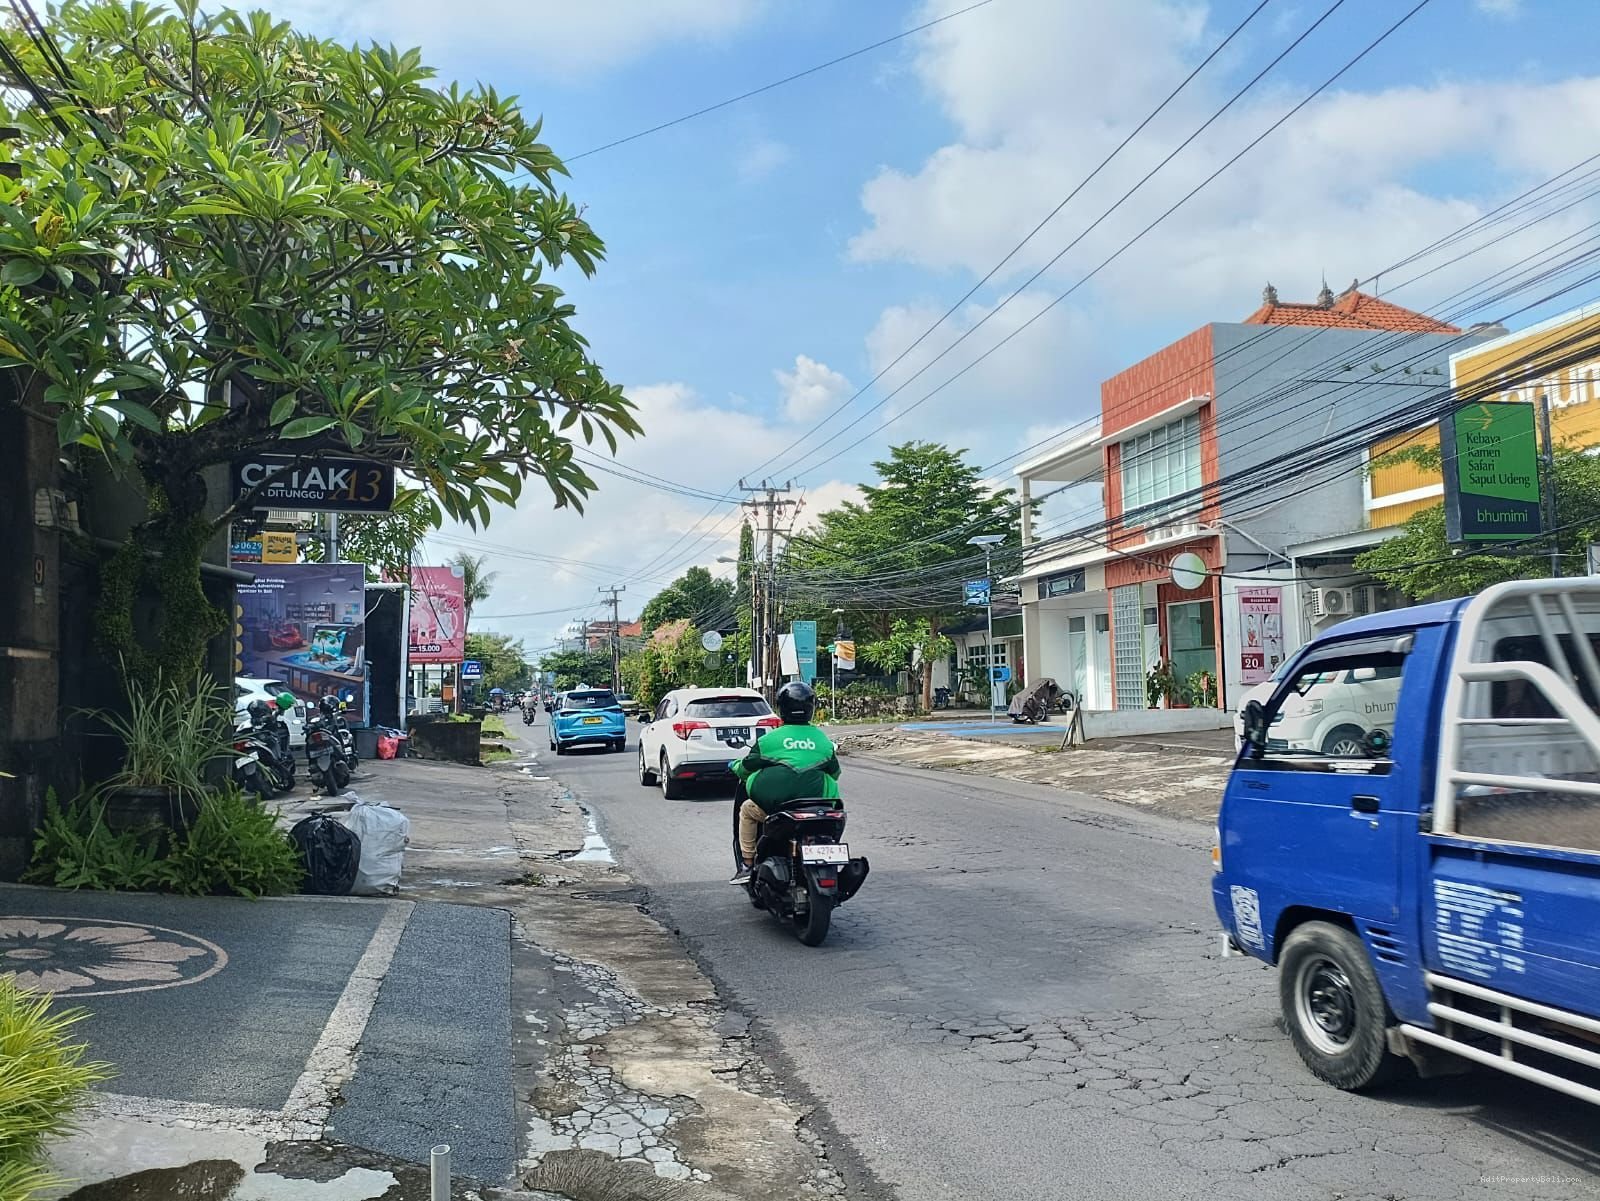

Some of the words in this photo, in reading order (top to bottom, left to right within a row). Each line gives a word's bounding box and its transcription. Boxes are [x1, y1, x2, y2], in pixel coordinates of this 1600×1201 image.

[1466, 431, 1501, 447] Kebaya
[1467, 447, 1500, 458] Kamen
[1468, 460, 1495, 471] Safari
[1469, 473, 1496, 487] Saput
[1499, 473, 1531, 488] Udeng
[267, 488, 324, 500] DITUNGGU
[1477, 508, 1528, 523] bhumimi
[1245, 658, 1259, 668] 20
[783, 737, 816, 750] Grab
